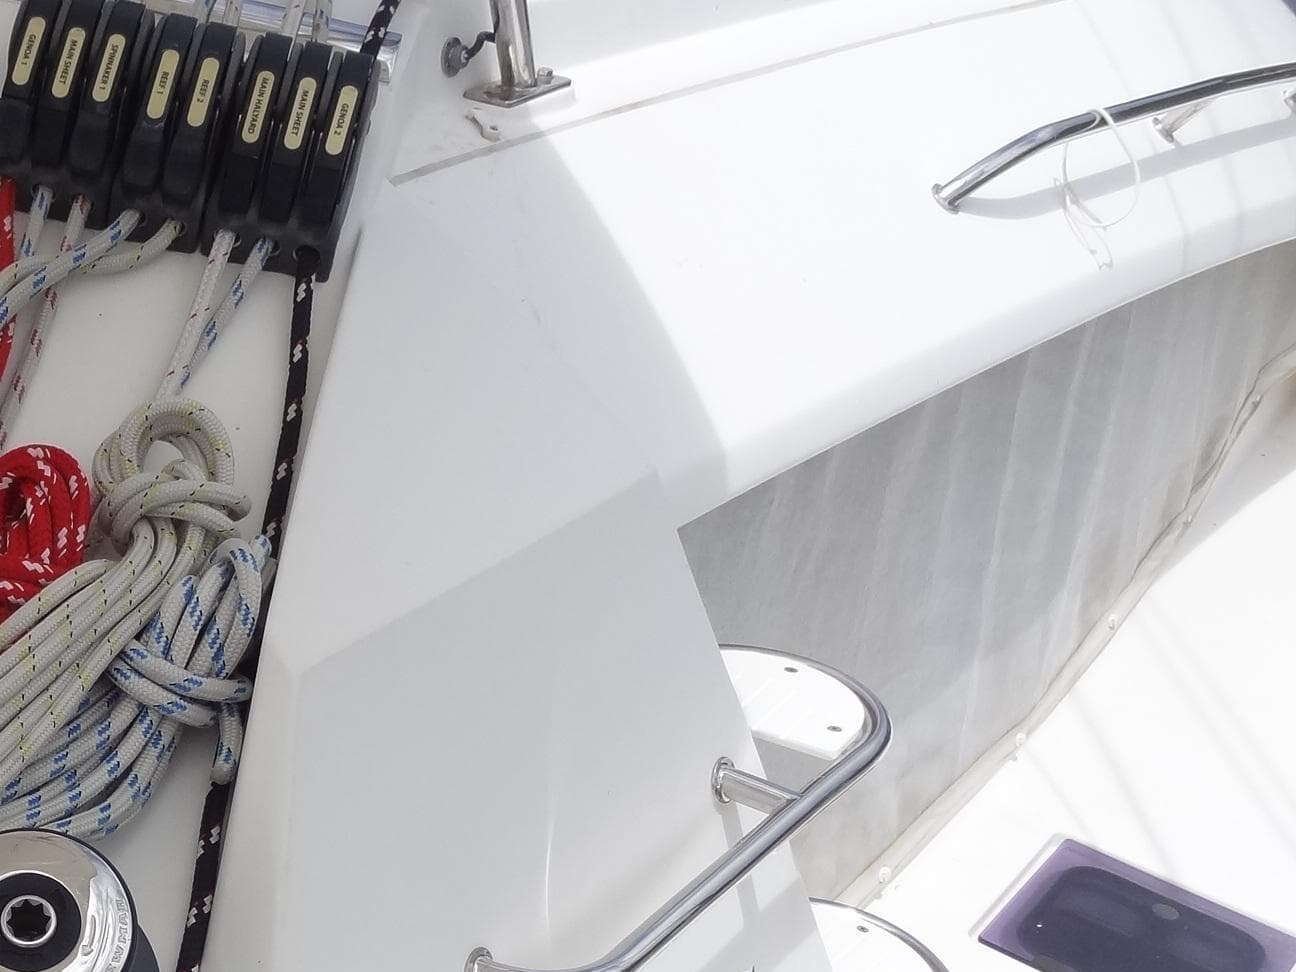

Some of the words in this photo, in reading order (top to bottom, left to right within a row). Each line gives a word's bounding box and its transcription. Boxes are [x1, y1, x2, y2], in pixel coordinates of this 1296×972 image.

[23, 33, 37, 60] GENOA
[65, 39, 78, 60] MAIN
[59, 60, 72, 85] SHEET
[159, 71, 170, 89] REEF
[199, 79, 210, 97] REEF
[257, 77, 268, 98] MAIN
[298, 90, 310, 111] MAIN
[247, 98, 264, 135] HALYARD
[290, 110, 304, 136] SHEET
[336, 103, 350, 130] GENOA
